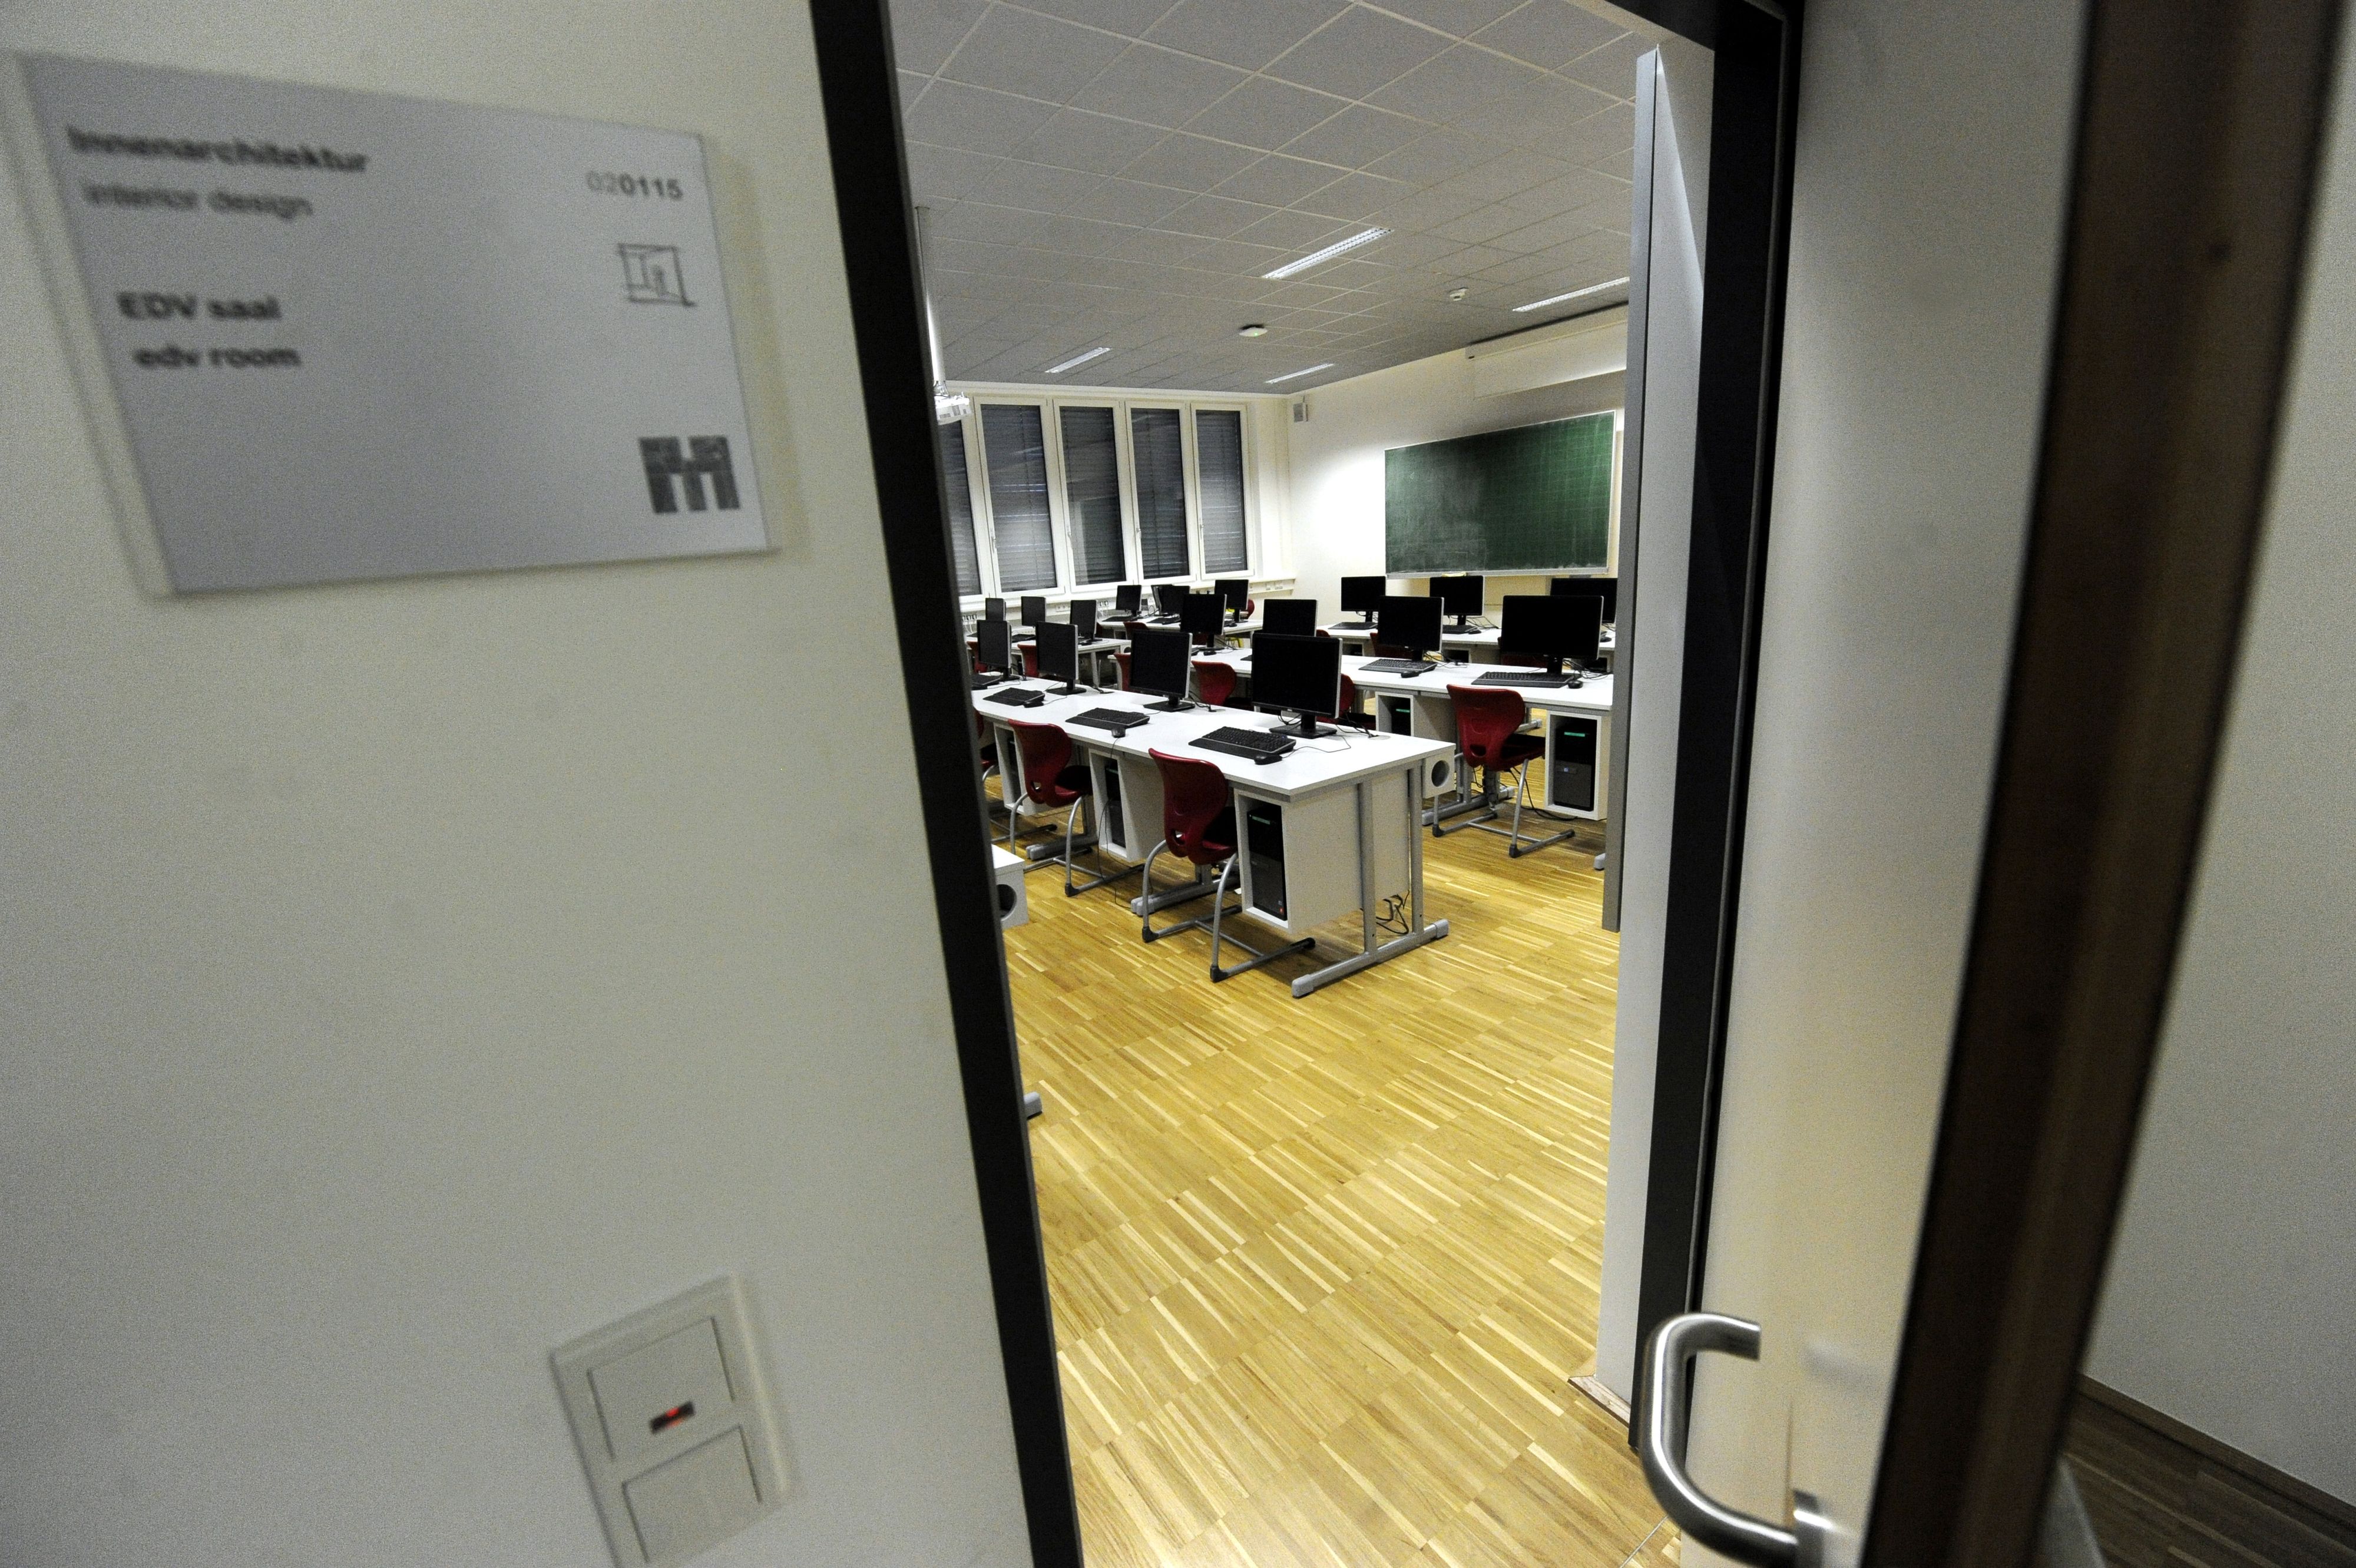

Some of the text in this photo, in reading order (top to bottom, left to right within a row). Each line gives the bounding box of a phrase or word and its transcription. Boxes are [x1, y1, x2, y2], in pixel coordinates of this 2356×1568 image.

[82, 179, 313, 220] interior design
[118, 293, 282, 320] EDV saal
[133, 345, 300, 369] edv room
